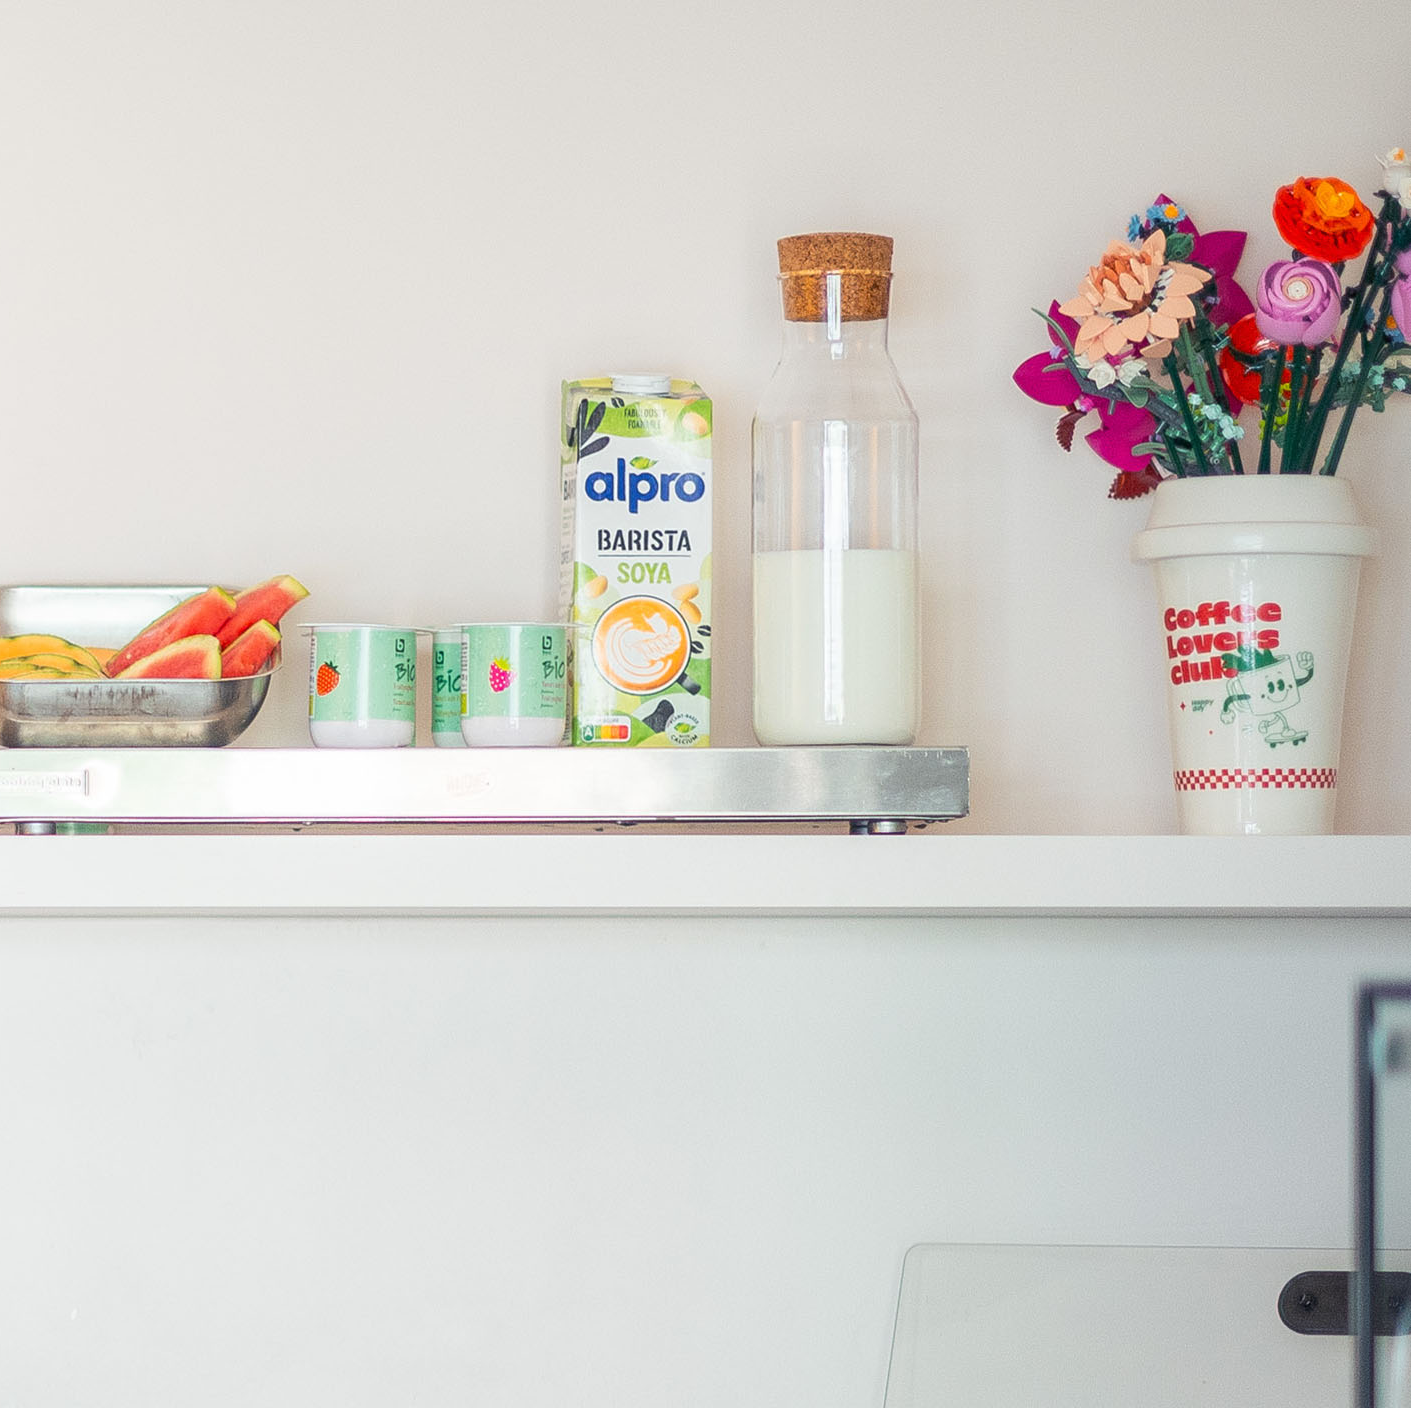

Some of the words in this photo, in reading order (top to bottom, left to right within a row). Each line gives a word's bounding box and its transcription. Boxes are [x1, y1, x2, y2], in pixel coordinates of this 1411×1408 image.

[584, 457, 705, 514] alpro
[597, 529, 692, 551] BARISTA
[617, 562, 672, 584] SOYA
[1163, 601, 1282, 632] Coffee
[1166, 629, 1280, 659] Lovers
